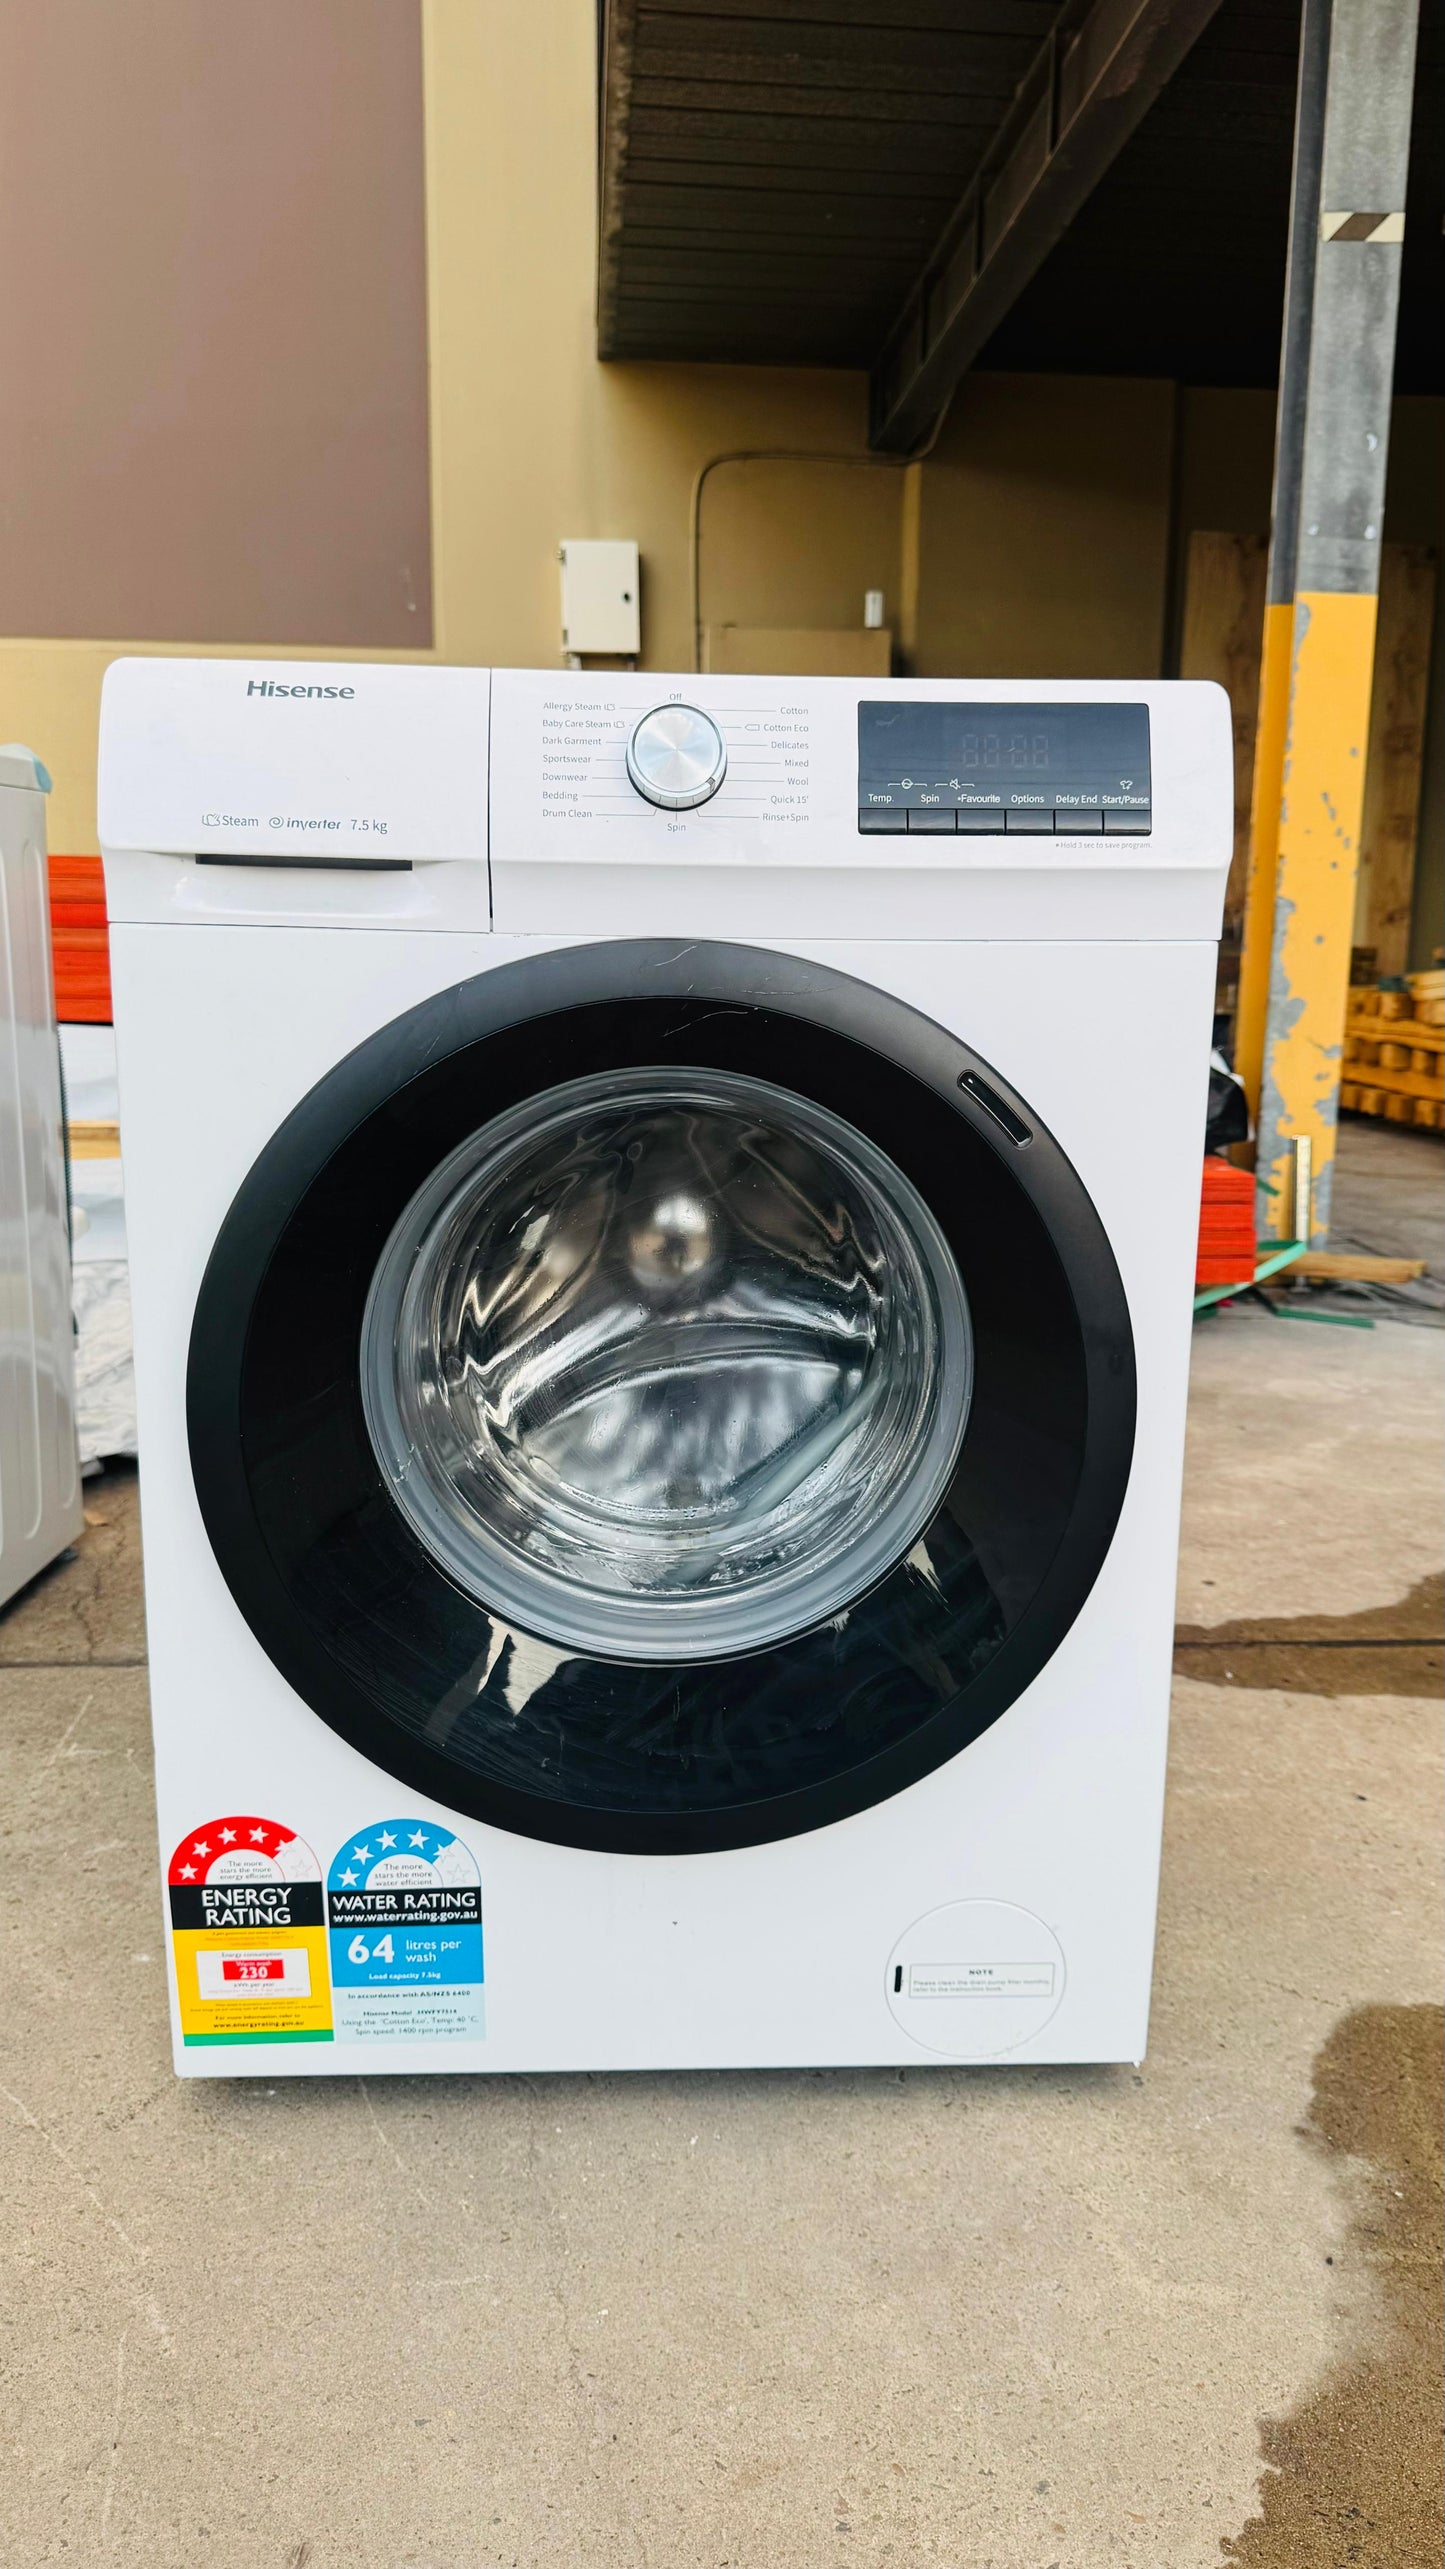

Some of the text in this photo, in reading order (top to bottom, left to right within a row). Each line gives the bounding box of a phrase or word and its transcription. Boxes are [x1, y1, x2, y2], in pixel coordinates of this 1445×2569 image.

[247, 681, 355, 699] Hisense
[670, 693, 682, 701] Off
[543, 702, 601, 712] Allergy Steam
[780, 707, 808, 715] Cotton
[543, 720, 563, 728] Baby
[565, 720, 584, 728] Care
[764, 724, 808, 732] Cotton Eco
[771, 741, 808, 750] Delicates
[543, 754, 591, 764] Sportswear
[543, 773, 588, 781] Downwear
[788, 778, 808, 786] Wool
[543, 792, 578, 801] Bedding
[770, 796, 794, 804] Quick
[920, 794, 940, 804] Spin
[1011, 794, 1044, 804] Options
[1056, 795, 1098, 804] Delay End
[1102, 795, 1149, 804] Start/Pause
[543, 809, 592, 818] Drum Clean
[762, 813, 808, 823] Rinse+Spin
[222, 815, 258, 827] Steam
[287, 817, 342, 830] inverter
[351, 819, 388, 834] 7.5 kg
[668, 823, 686, 832] Spin
[202, 1888, 292, 1907] ENERGY
[333, 1892, 476, 1911] WATER RATING
[206, 1907, 291, 1926] RATING
[334, 1910, 478, 1923] www.waterrating.gov.au
[348, 1934, 394, 1964] 64
[406, 1940, 461, 1952] litres per
[406, 1952, 436, 1962] wash
[240, 1966, 268, 1979] 230
